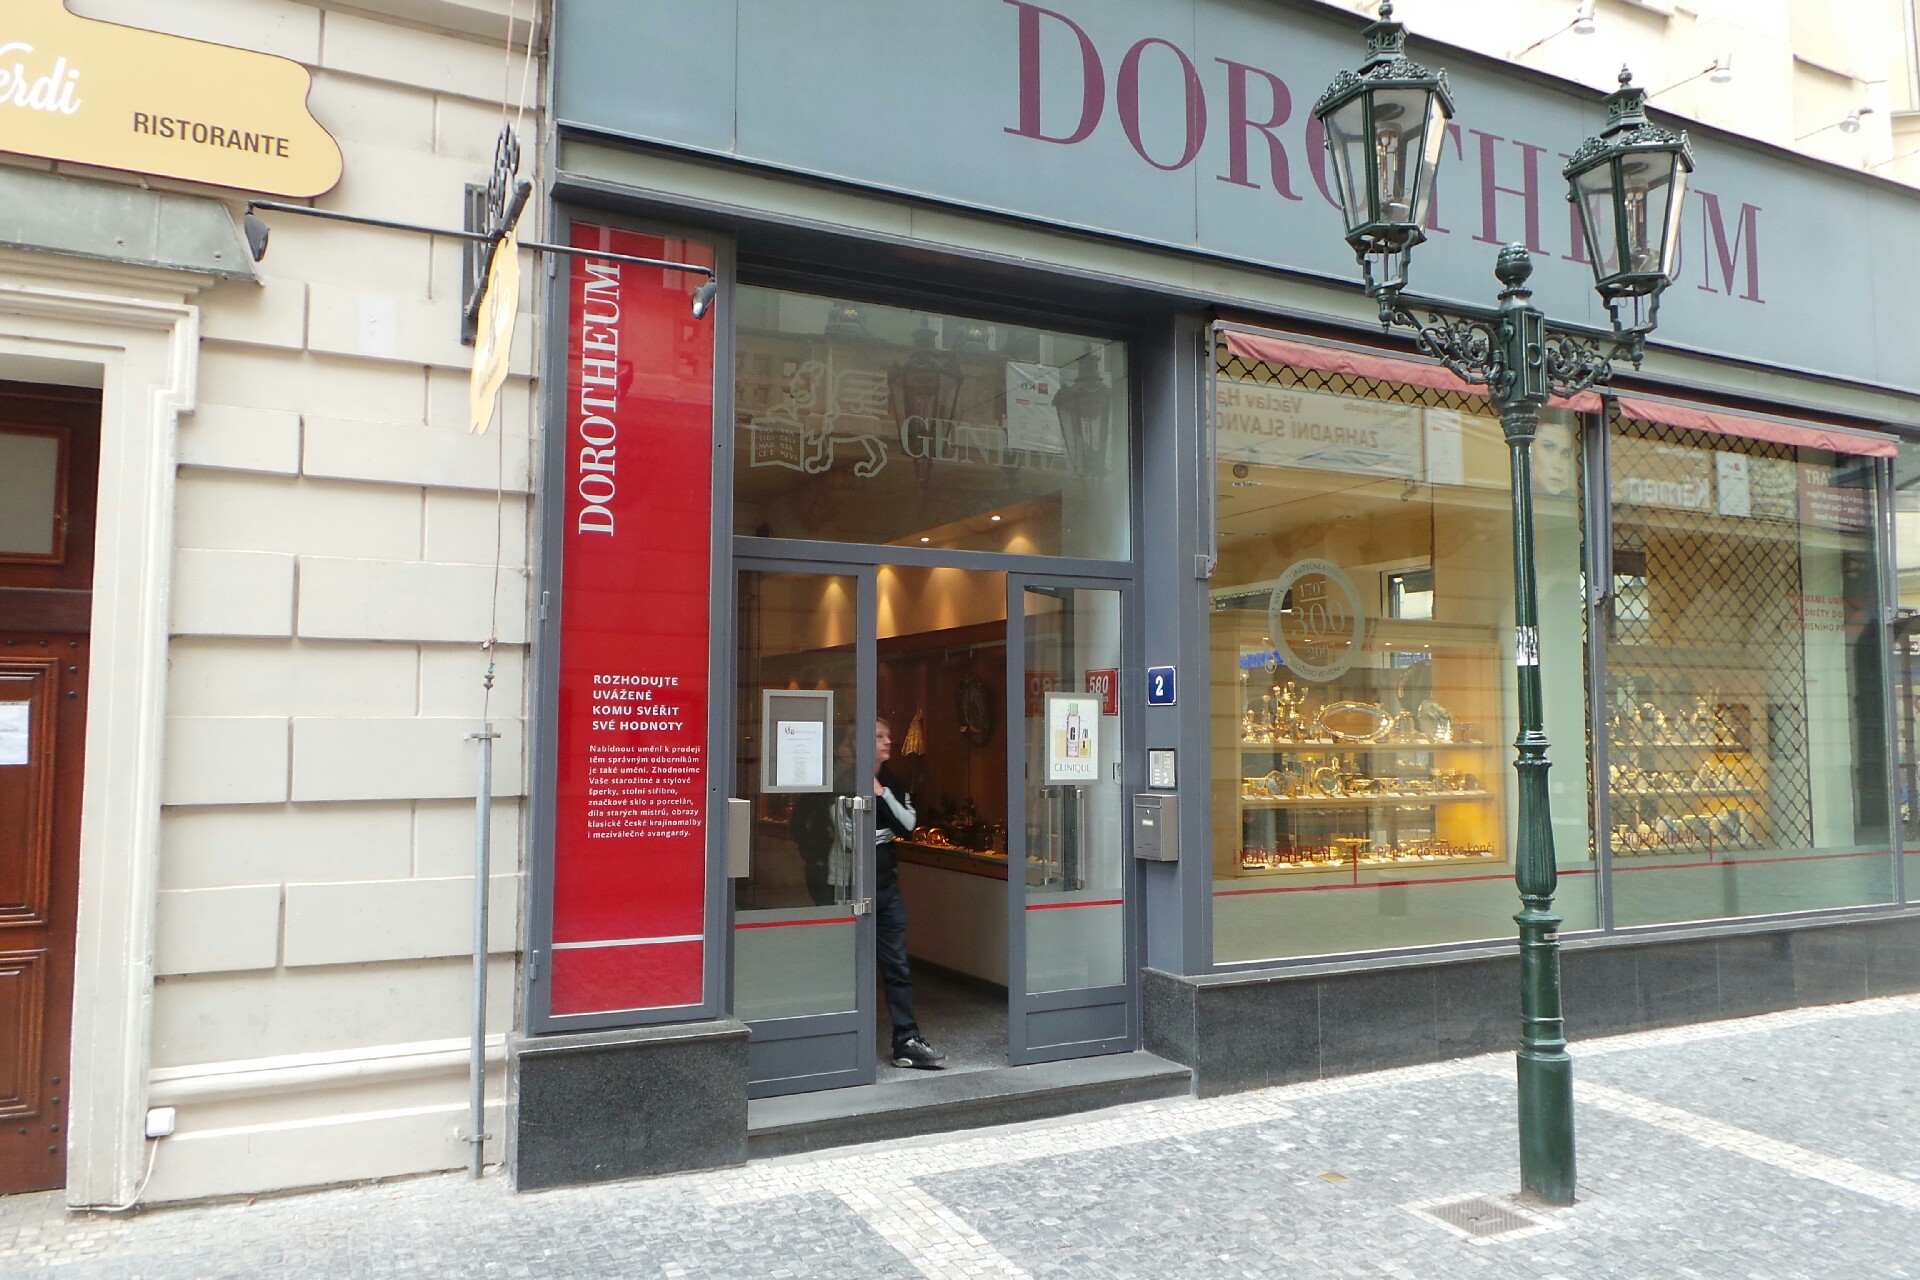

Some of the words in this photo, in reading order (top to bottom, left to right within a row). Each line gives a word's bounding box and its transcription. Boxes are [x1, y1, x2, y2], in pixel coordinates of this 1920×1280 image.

[0, 41, 82, 115] erdi
[133, 111, 290, 158] RISTORANTE
[1004, 0, 1765, 304] DORHEM
[578, 260, 621, 537] DOROTHEUM
[1291, 602, 1346, 637] 300
[593, 674, 679, 688] ROZHODUJTE
[1089, 675, 1109, 694] 580
[1155, 675, 1164, 696] 2
[592, 705, 632, 715] KOMU
[636, 704, 680, 716] SVĚŘIT
[592, 718, 616, 730] SVÉ
[619, 720, 683, 731] HODNOTY
[589, 767, 596, 775] je
[1054, 763, 1092, 774] CLINIQUE
[1416, 844, 1431, 857] do
[1433, 844, 1465, 856] aukce
[1465, 841, 1495, 855] končí
